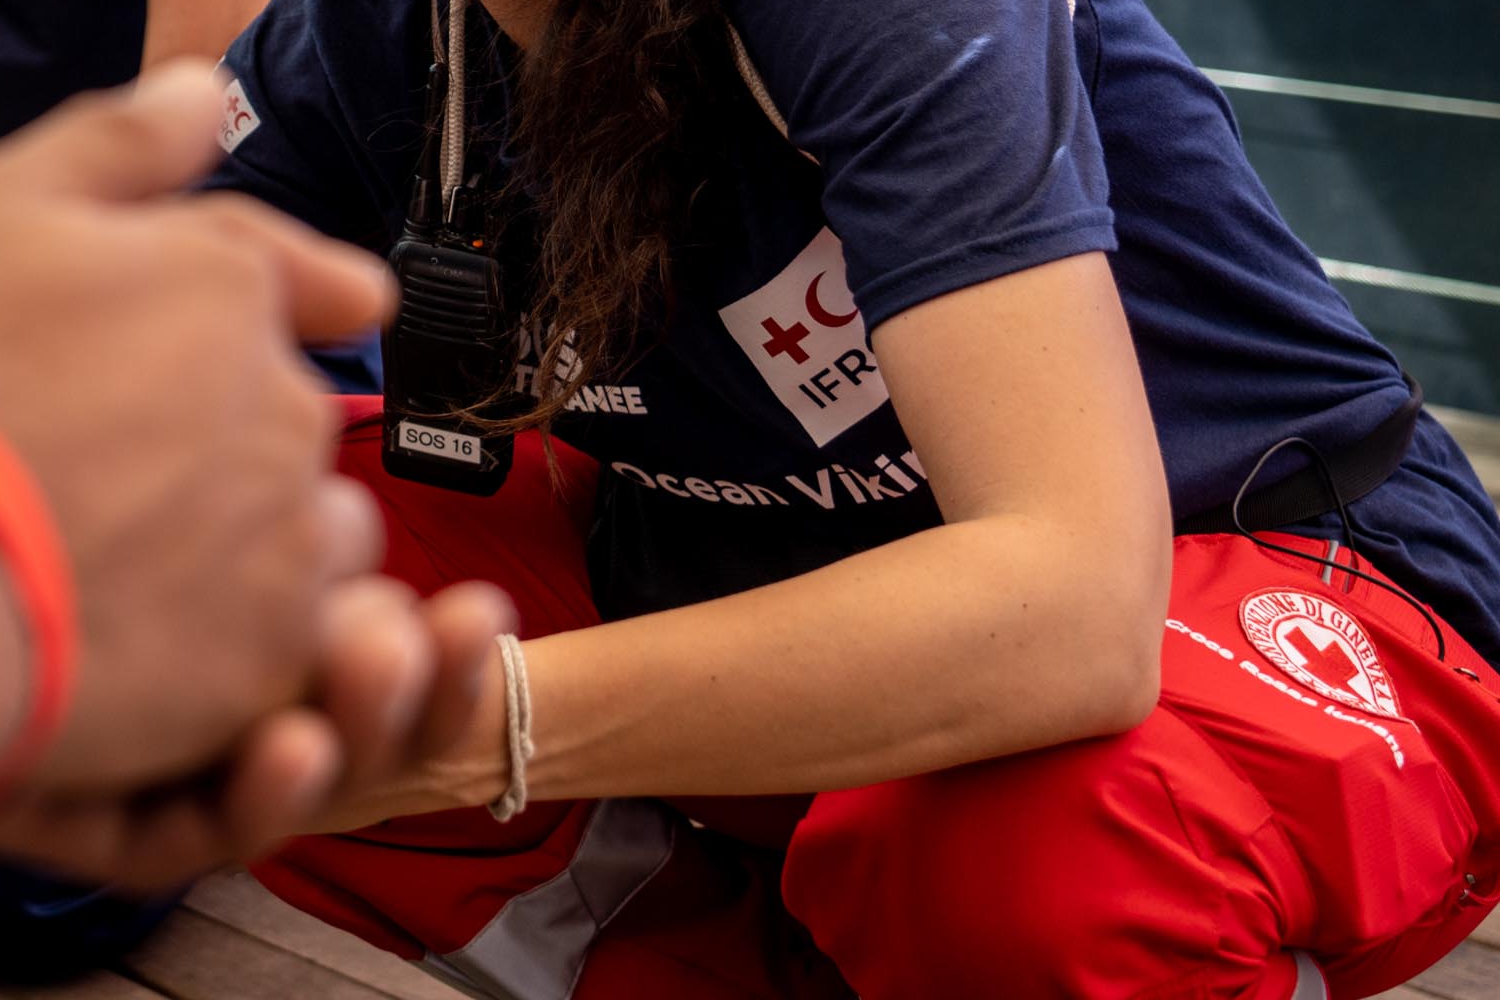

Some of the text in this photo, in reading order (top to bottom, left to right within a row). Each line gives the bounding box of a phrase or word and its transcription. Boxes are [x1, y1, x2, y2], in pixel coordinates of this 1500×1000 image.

[798, 338, 878, 410] IFR
[406, 428, 473, 456] SOS 16
[611, 449, 928, 510] Ocean Viki
[1300, 596, 1325, 624] DI
[1330, 610, 1393, 702] GINEVRA
